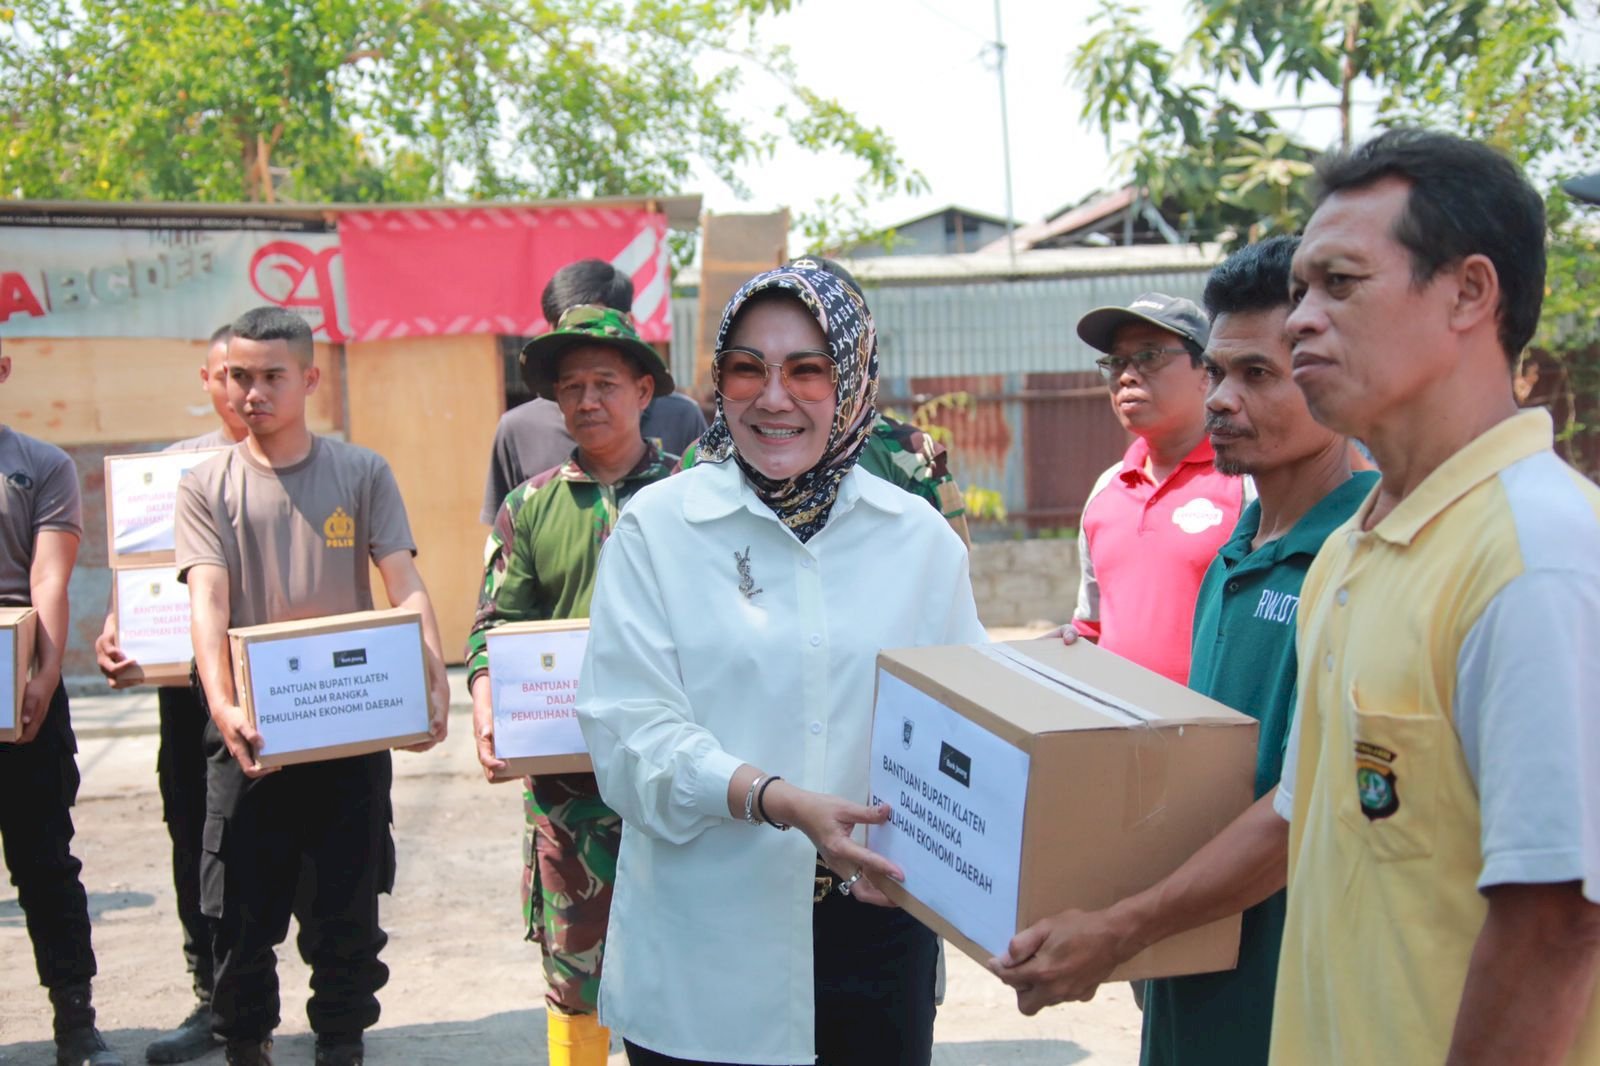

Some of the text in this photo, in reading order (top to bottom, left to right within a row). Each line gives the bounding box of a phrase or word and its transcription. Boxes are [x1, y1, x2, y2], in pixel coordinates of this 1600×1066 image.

[269, 672, 389, 696] BANTUAN BUPATI KLATEN
[522, 680, 570, 693] BANTUAN
[260, 697, 404, 725] PEMULIHAN EKONOMI DAERAH
[294, 689, 368, 707] DALAM RANGKA
[511, 709, 569, 722] PEMULIHAN
[883, 755, 986, 836] BANTUAN BUPATI KLATEN
[900, 791, 962, 848] DALAM RANGKA
[873, 795, 992, 894] PEULIHAN EKONOMI DAERAH
